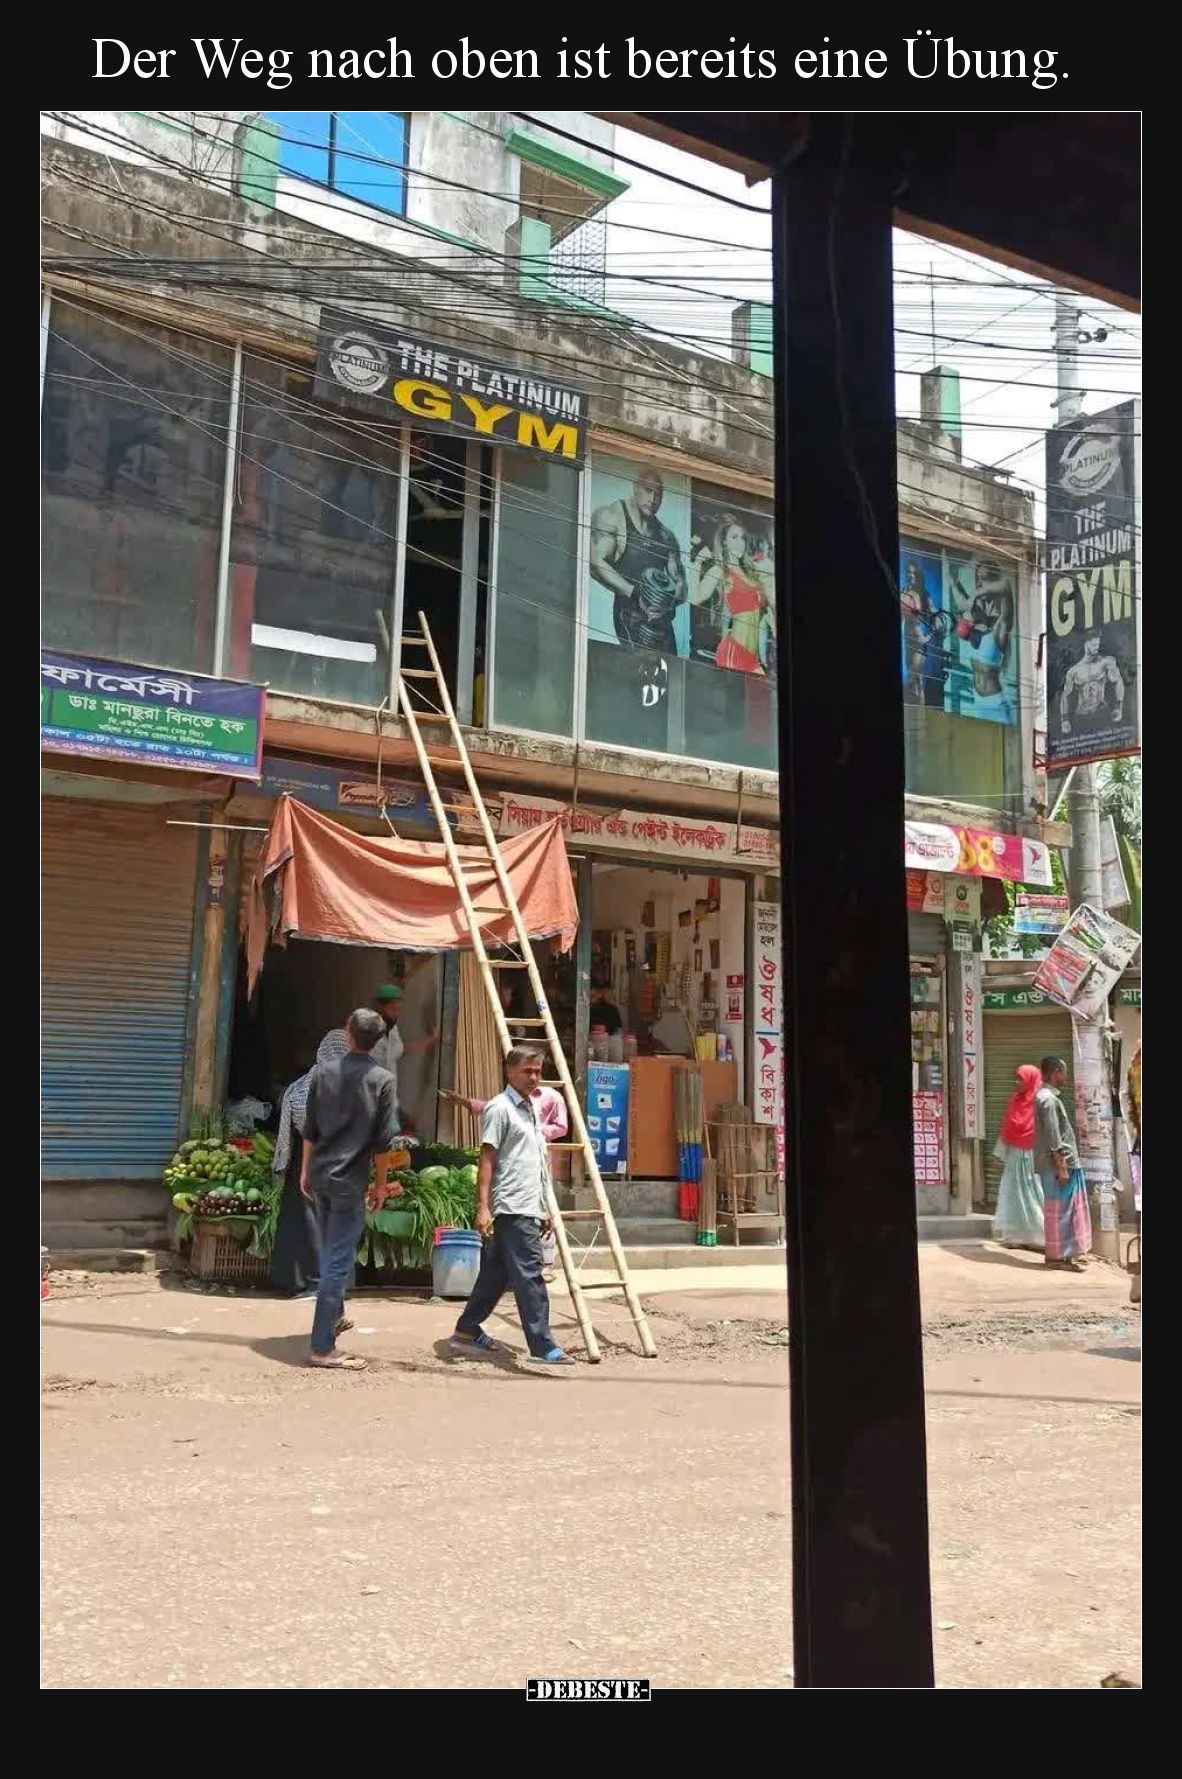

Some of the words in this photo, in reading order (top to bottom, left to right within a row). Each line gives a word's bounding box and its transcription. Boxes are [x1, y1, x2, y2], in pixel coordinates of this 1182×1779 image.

[397, 340, 449, 381] THE
[457, 359, 580, 421] PLATINUM
[394, 378, 577, 459] GYM
[1050, 525, 1134, 570] PLATINUM
[1077, 500, 1106, 535] THE
[1051, 560, 1132, 636] GYM
[68, 694, 98, 711] ডাঃ
[166, 706, 215, 729] বিনতে
[219, 718, 247, 735] হক
